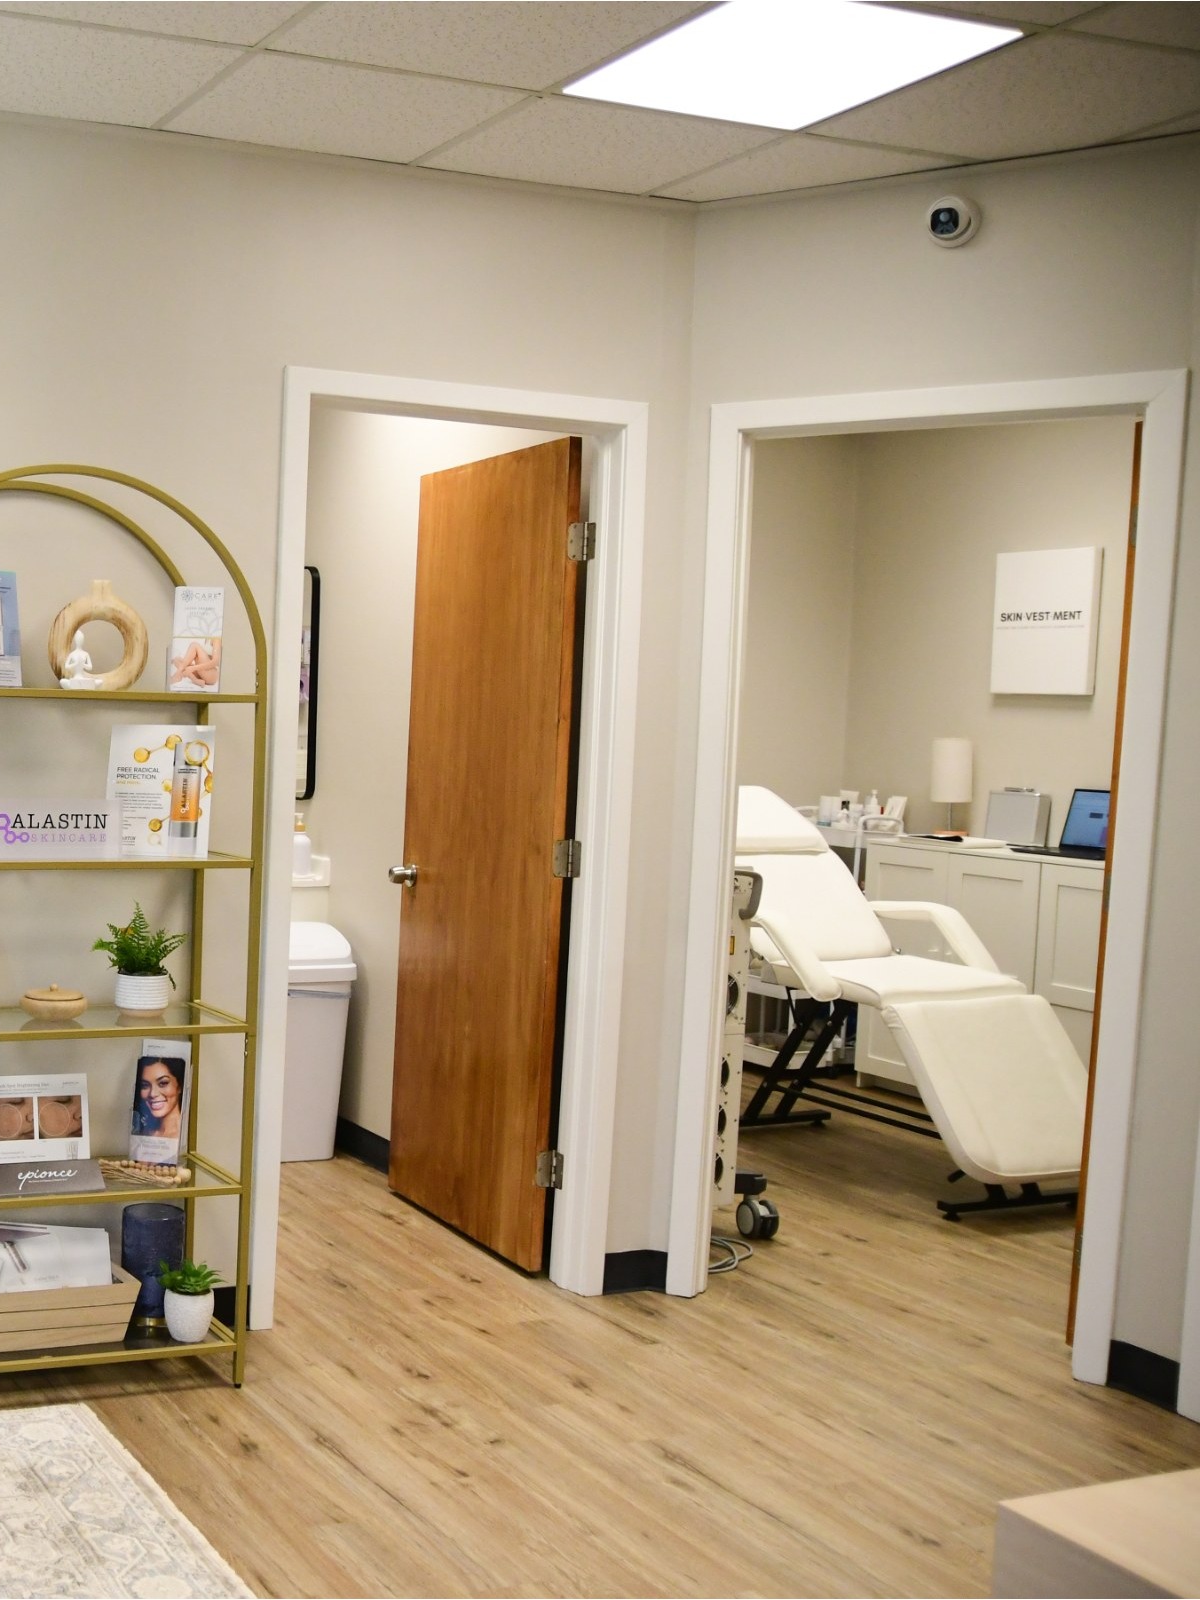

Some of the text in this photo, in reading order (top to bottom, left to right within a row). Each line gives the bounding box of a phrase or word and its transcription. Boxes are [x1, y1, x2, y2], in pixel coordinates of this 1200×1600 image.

[1000, 610, 1083, 622] SKIN VEST MENT
[10, 813, 108, 830] ALASTIN
[30, 833, 107, 843] SKINCARE
[17, 1168, 78, 1191] epionce
